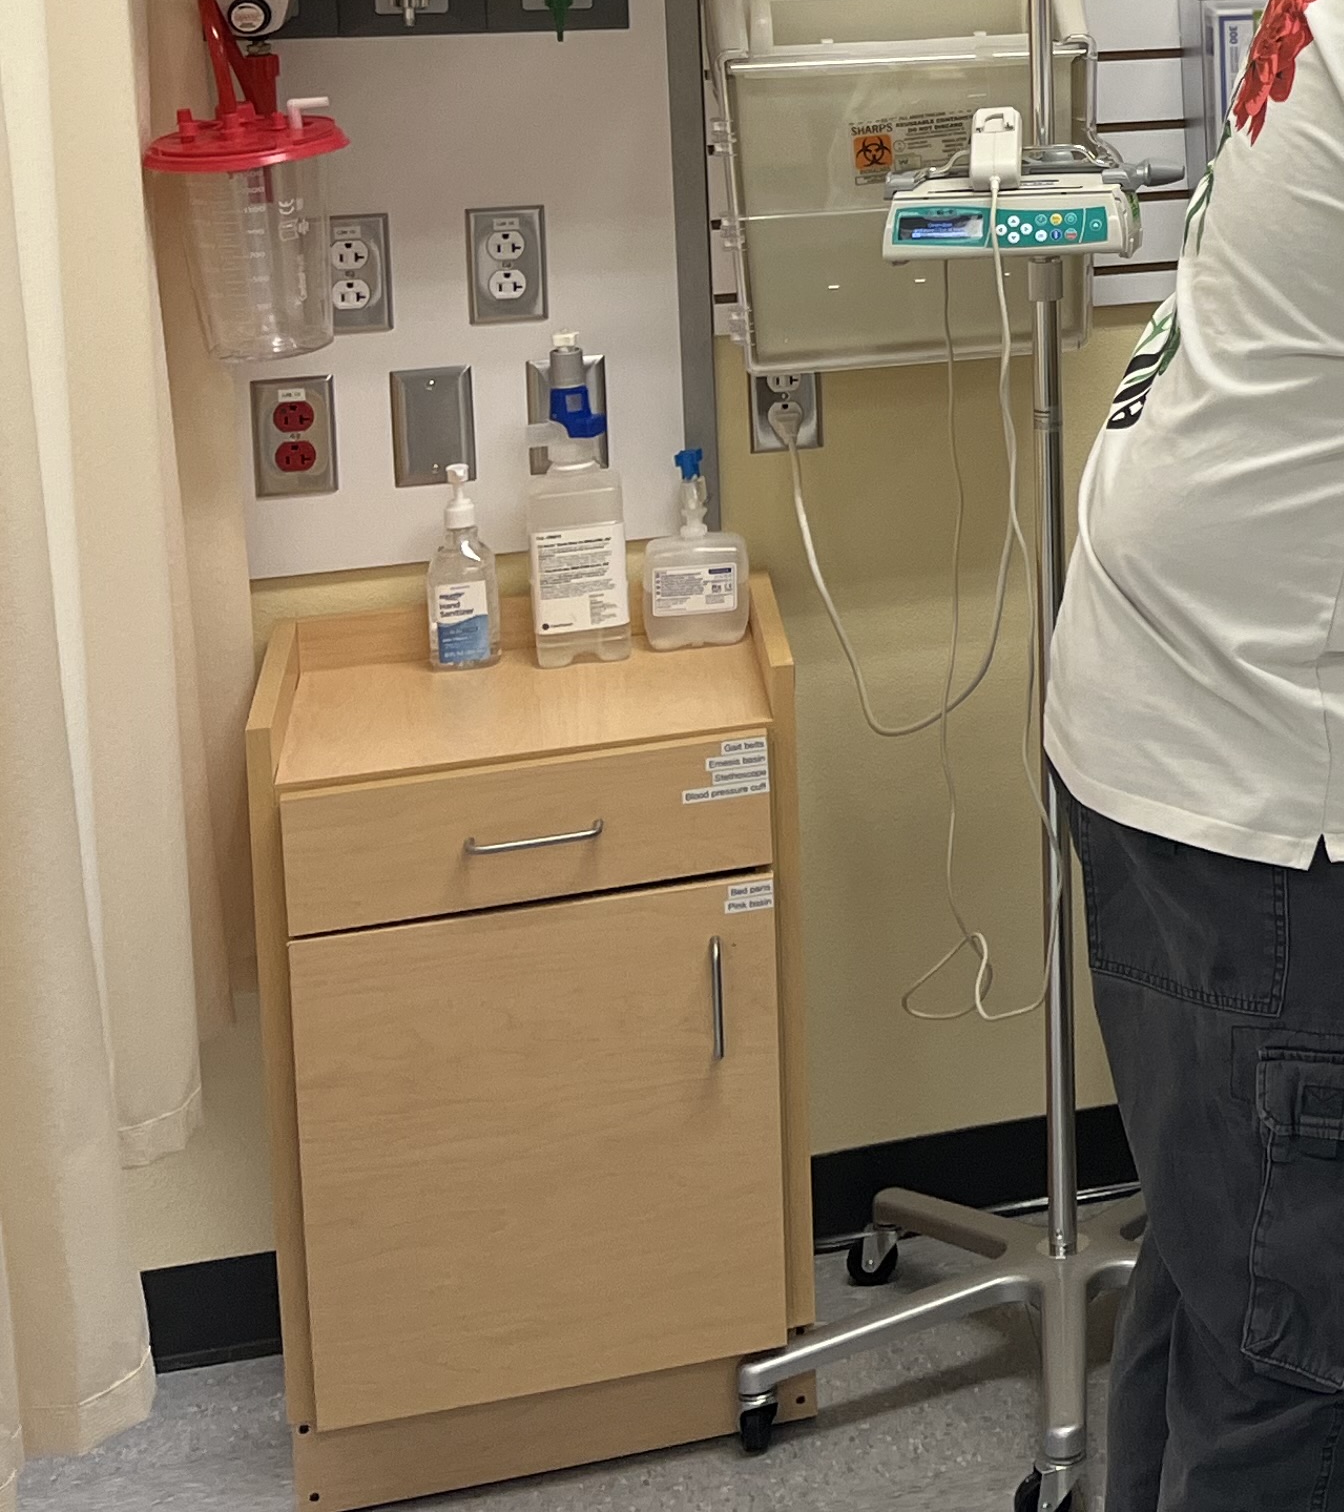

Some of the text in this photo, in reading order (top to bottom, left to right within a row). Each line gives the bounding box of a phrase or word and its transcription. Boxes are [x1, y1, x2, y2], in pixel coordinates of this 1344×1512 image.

[851, 123, 893, 136] SHARPS
[744, 740, 764, 750] belts
[708, 755, 766, 769] Emesis basin
[714, 769, 767, 782] Stethoscope
[685, 782, 767, 801] Blood pressure cuff
[730, 887, 748, 897] Bed
[727, 901, 747, 911] Pink
